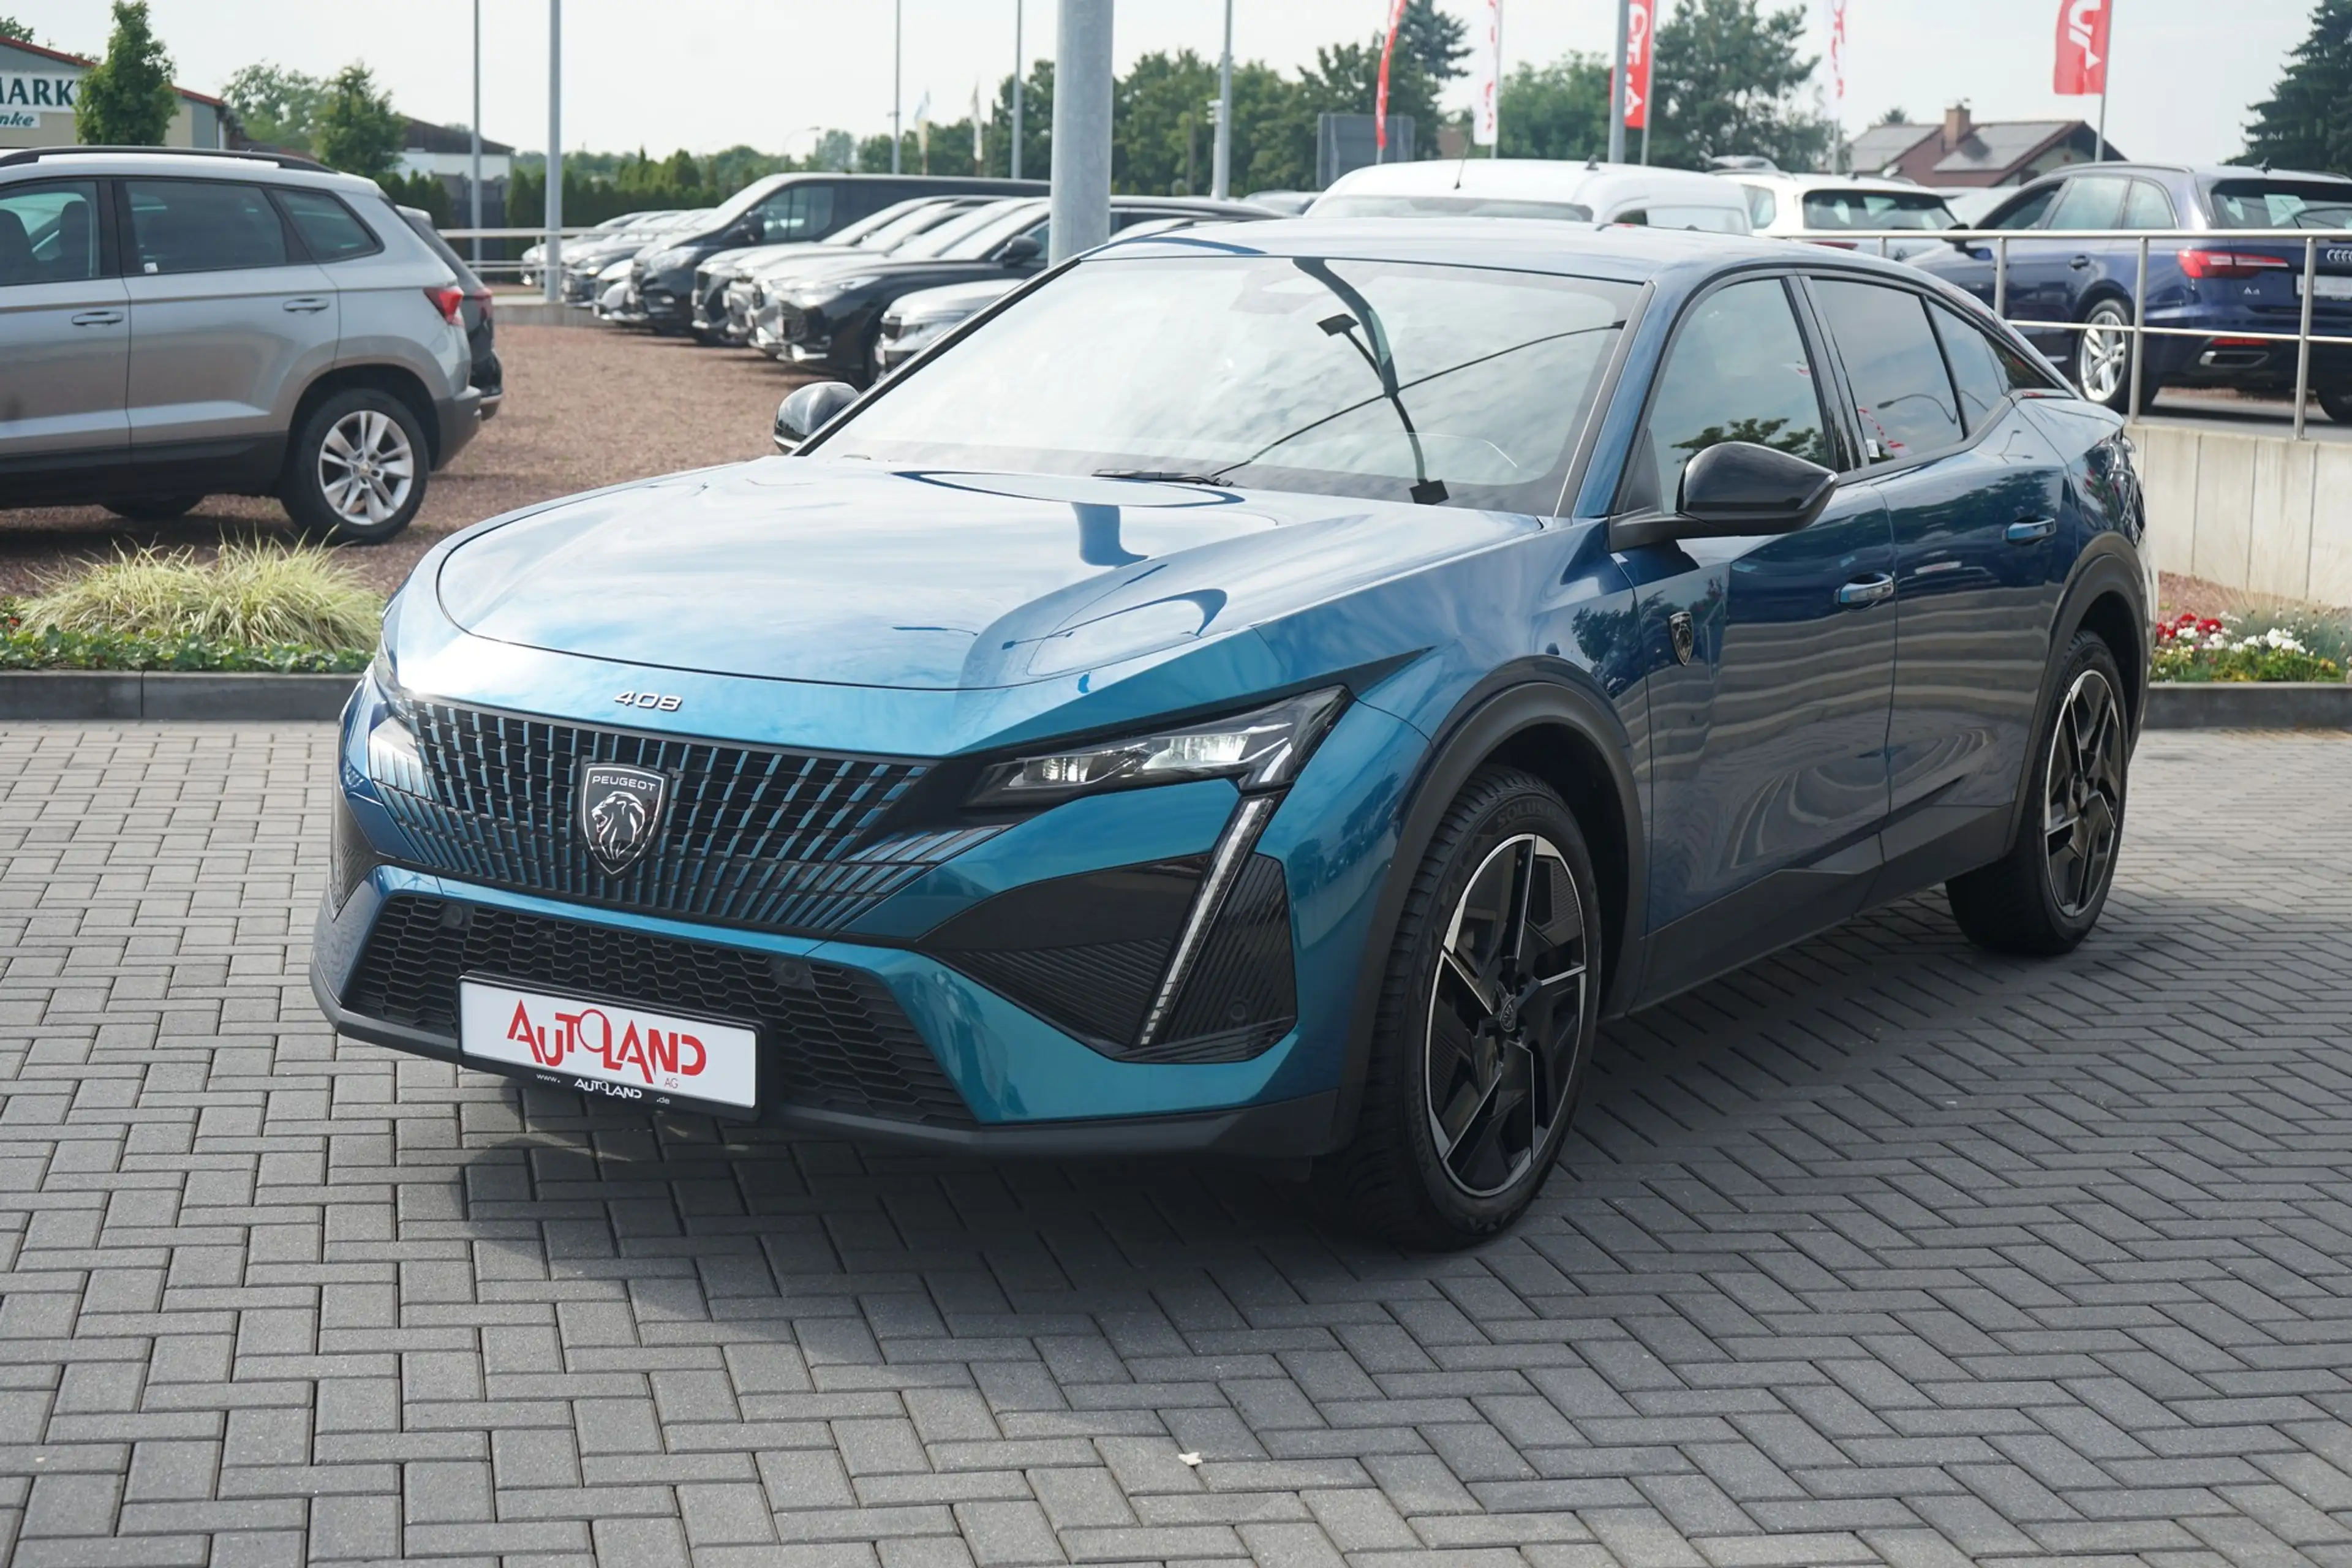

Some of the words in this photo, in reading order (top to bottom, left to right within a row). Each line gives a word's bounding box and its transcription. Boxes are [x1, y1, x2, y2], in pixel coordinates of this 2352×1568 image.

[614, 690, 682, 712] 408
[592, 775, 657, 791] PEUGEOT
[507, 1000, 706, 1084] AUTOLAND
[664, 1077, 679, 1089] AG
